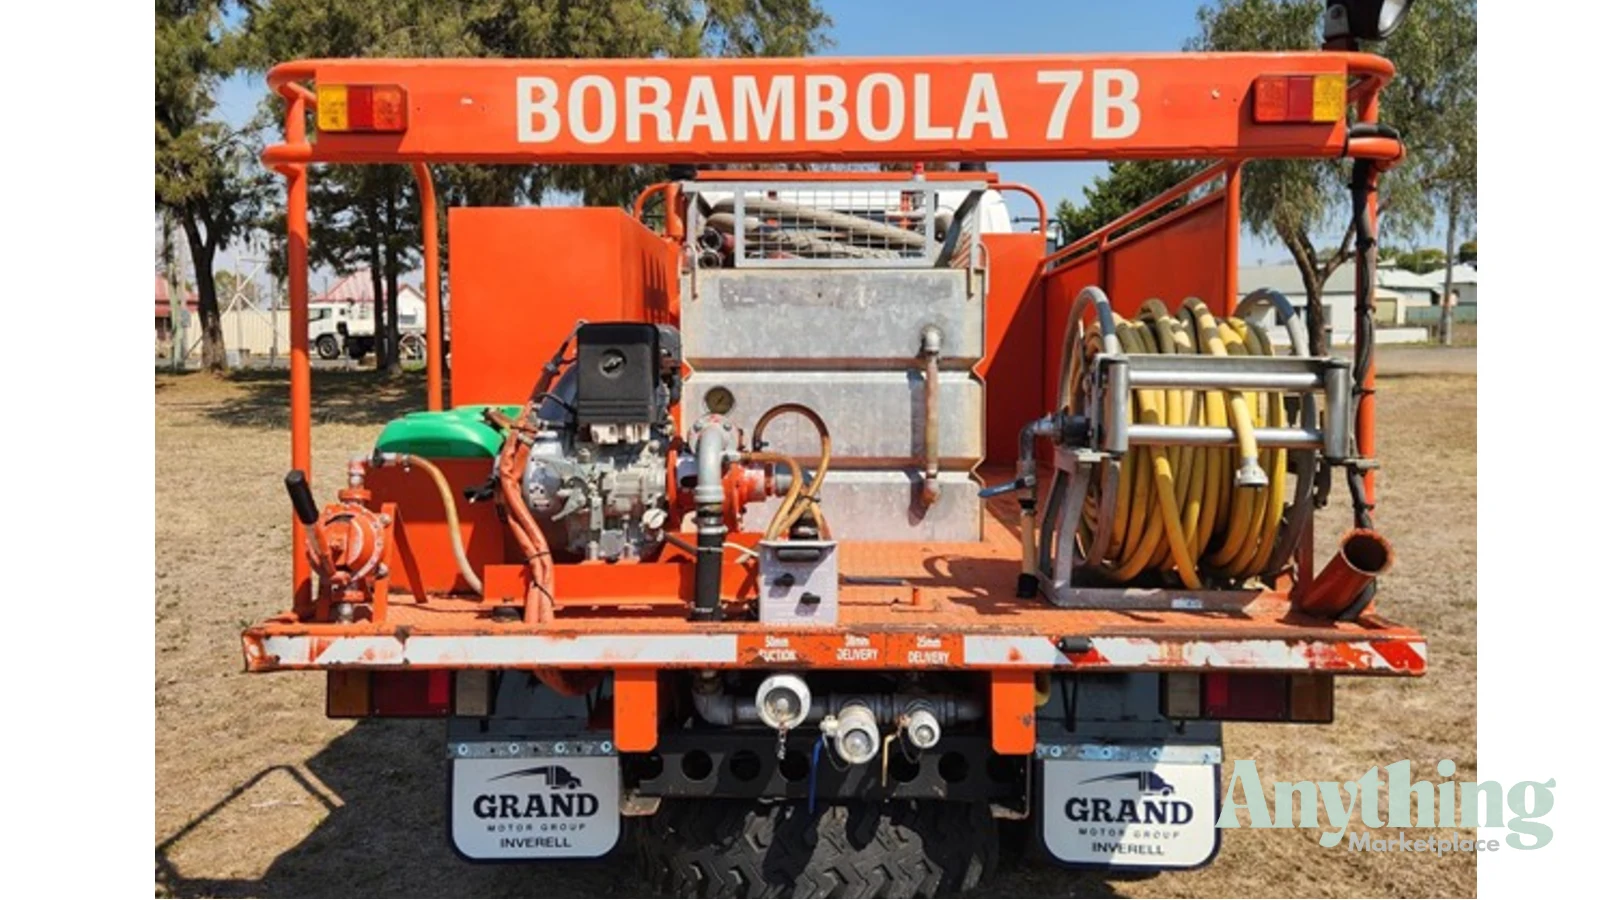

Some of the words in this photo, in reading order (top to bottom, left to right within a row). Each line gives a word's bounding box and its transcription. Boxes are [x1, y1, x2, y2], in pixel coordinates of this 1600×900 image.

[516, 73, 1008, 144] BORAMBOLA
[1037, 69, 1141, 141] 7B
[836, 648, 879, 661] DELIVERY
[907, 650, 950, 664] DELIVERY
[473, 793, 599, 819] GRAND
[1064, 797, 1194, 824] GRAND
[487, 823, 533, 832] MOTOR
[540, 823, 586, 832] GROUP
[1078, 827, 1125, 837] MOTOR
[1133, 830, 1180, 839] GROUP
[500, 837, 572, 848] INVERELL
[1092, 842, 1165, 855] INVERELL
